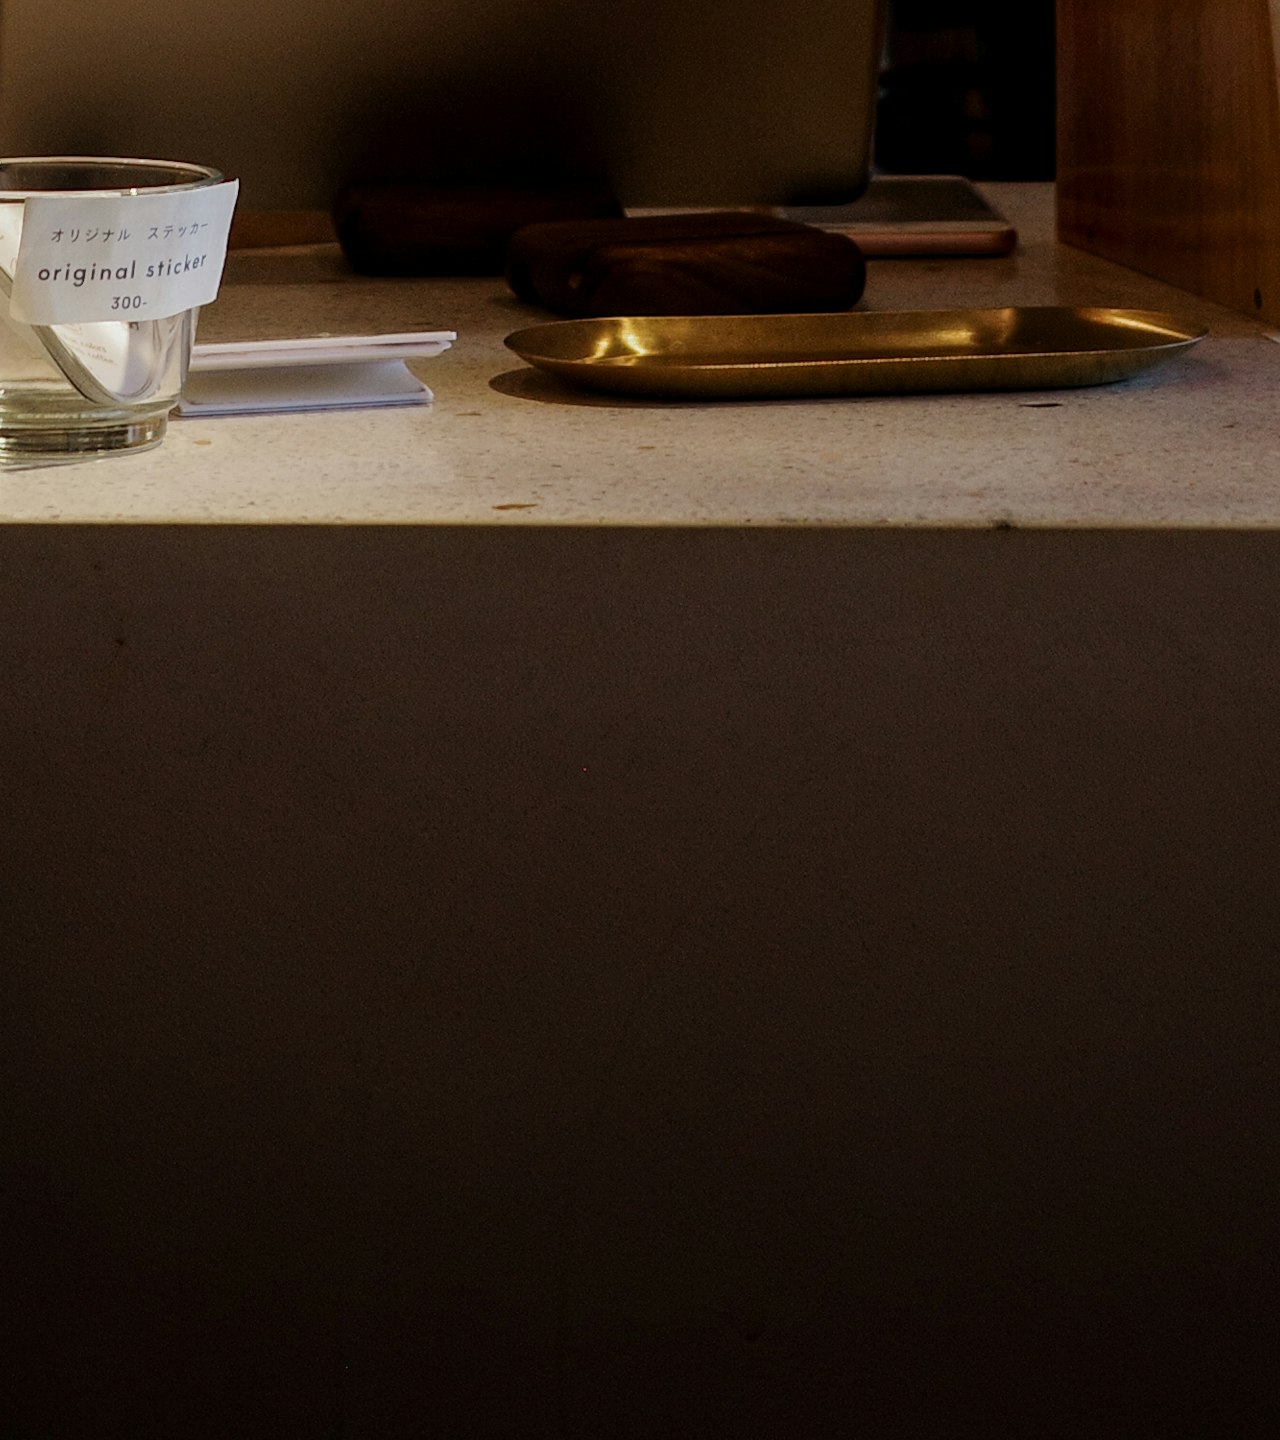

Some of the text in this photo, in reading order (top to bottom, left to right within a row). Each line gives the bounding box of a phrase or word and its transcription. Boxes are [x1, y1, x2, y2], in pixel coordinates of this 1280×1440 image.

[51, 221, 209, 243] オリジナル ステッカー
[38, 254, 207, 287] original sticker
[111, 295, 148, 310] 300-
